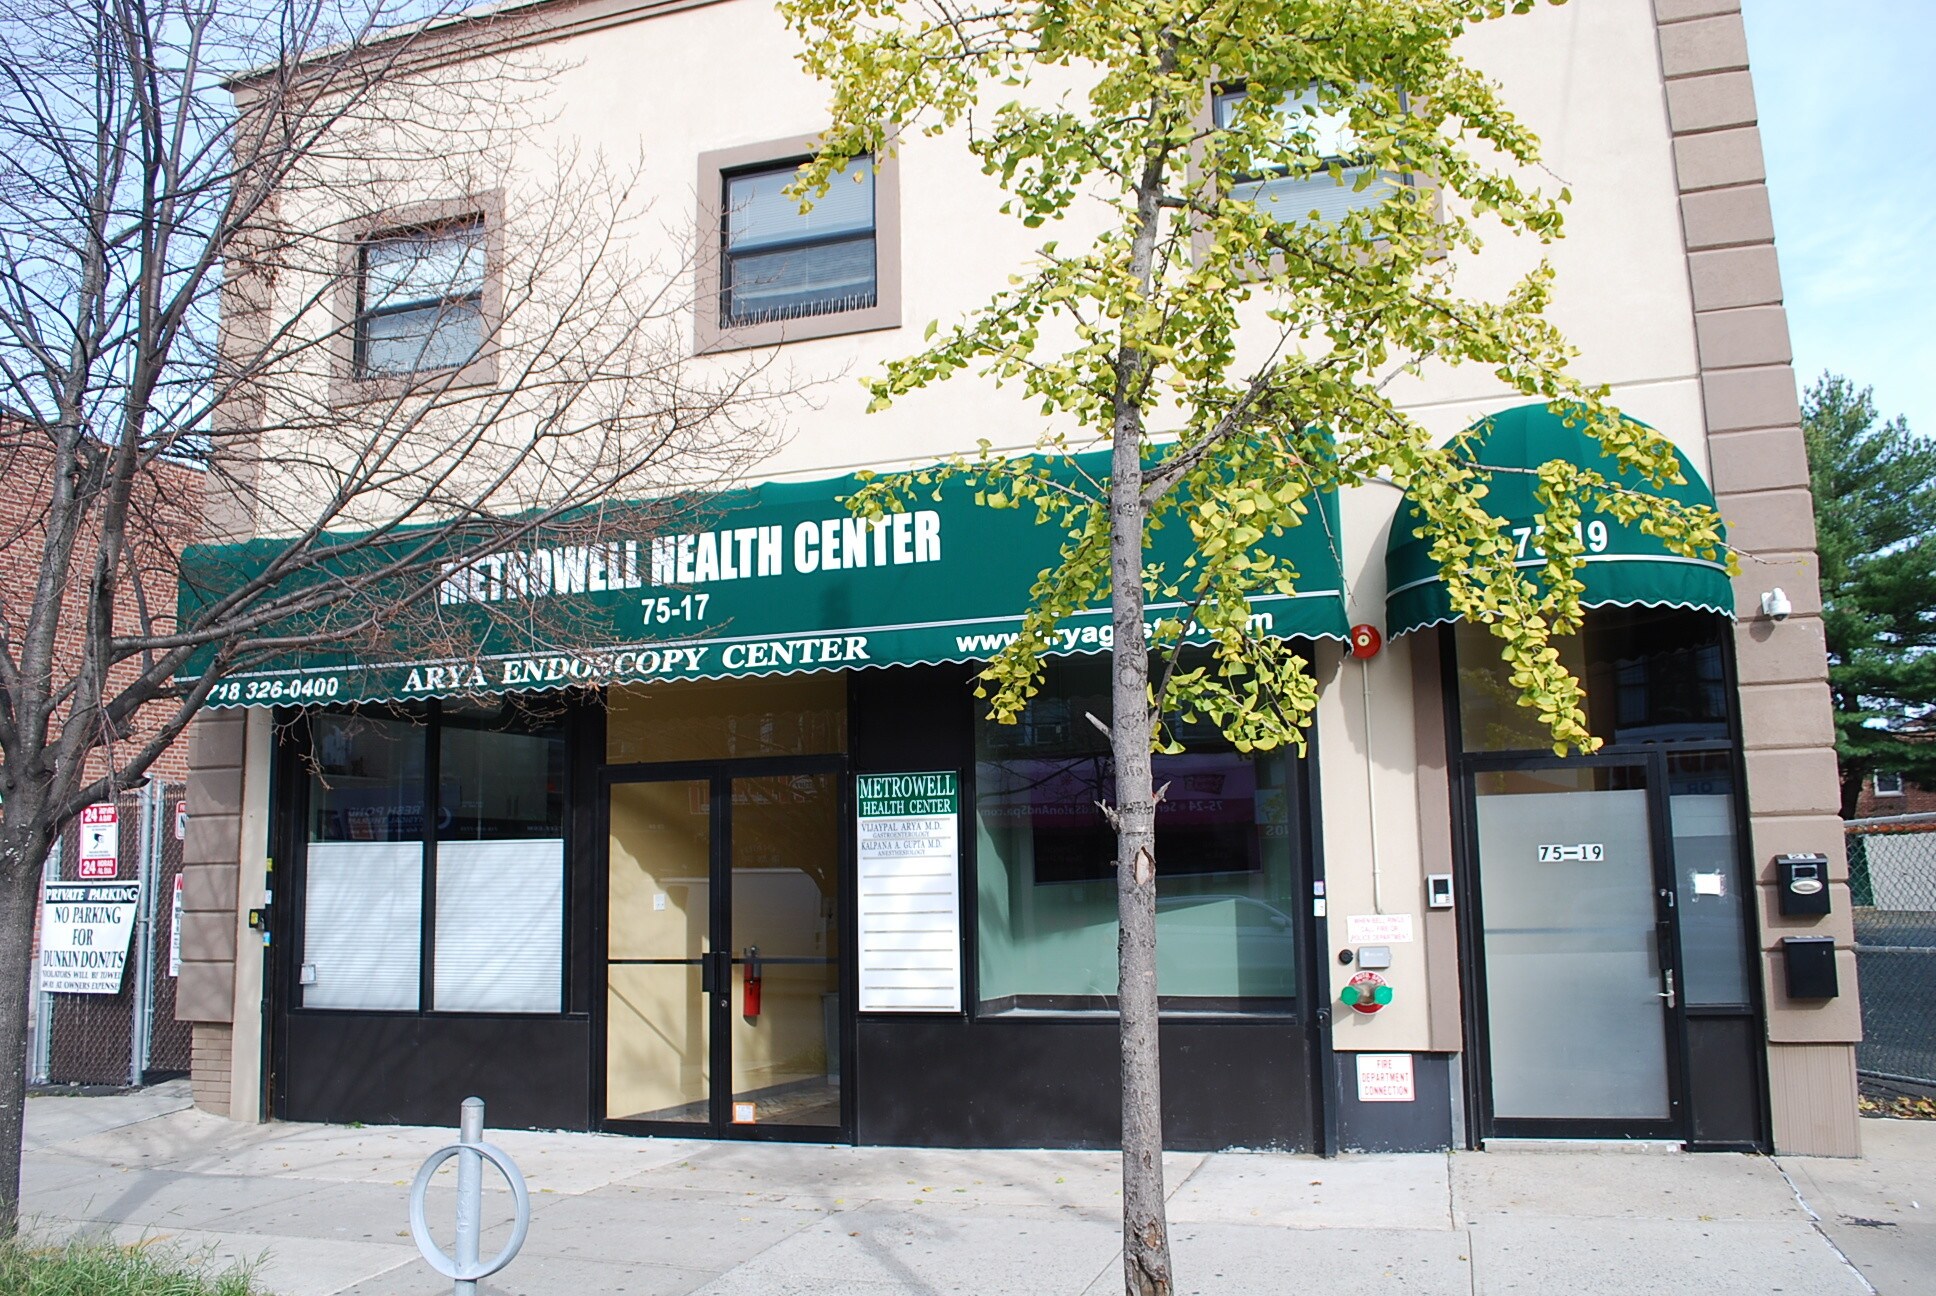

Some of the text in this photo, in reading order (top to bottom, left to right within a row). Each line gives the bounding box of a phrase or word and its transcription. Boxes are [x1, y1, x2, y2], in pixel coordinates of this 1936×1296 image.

[440, 510, 941, 605] METROWELL HEALTH CENTER
[641, 594, 709, 625] 75-17
[401, 664, 487, 692] ARYA
[722, 636, 871, 668] CENTER
[245, 677, 339, 699] 326-0400
[859, 774, 955, 799] METROWELL
[863, 798, 952, 815] HEALTH CENTER
[84, 808, 97, 823] 24
[901, 822, 922, 831] ARYA
[861, 841, 892, 851] KALPANA
[903, 840, 925, 849] GUPTA
[1540, 846, 1601, 861] 75-19
[83, 860, 96, 875] 24
[46, 887, 138, 901] PRIVATE PARKING
[54, 906, 121, 924] NO PARKING
[72, 928, 93, 946] FOR
[43, 949, 125, 968] DUNKIN DONUTS
[42, 970, 71, 978] VIOLATORS
[73, 970, 89, 979] WILL
[64, 981, 90, 989] OWNERS
[1377, 1059, 1392, 1069] FIRE
[1362, 1072, 1408, 1082] DEPARTMENT
[1365, 1085, 1408, 1095] CONNECTION
